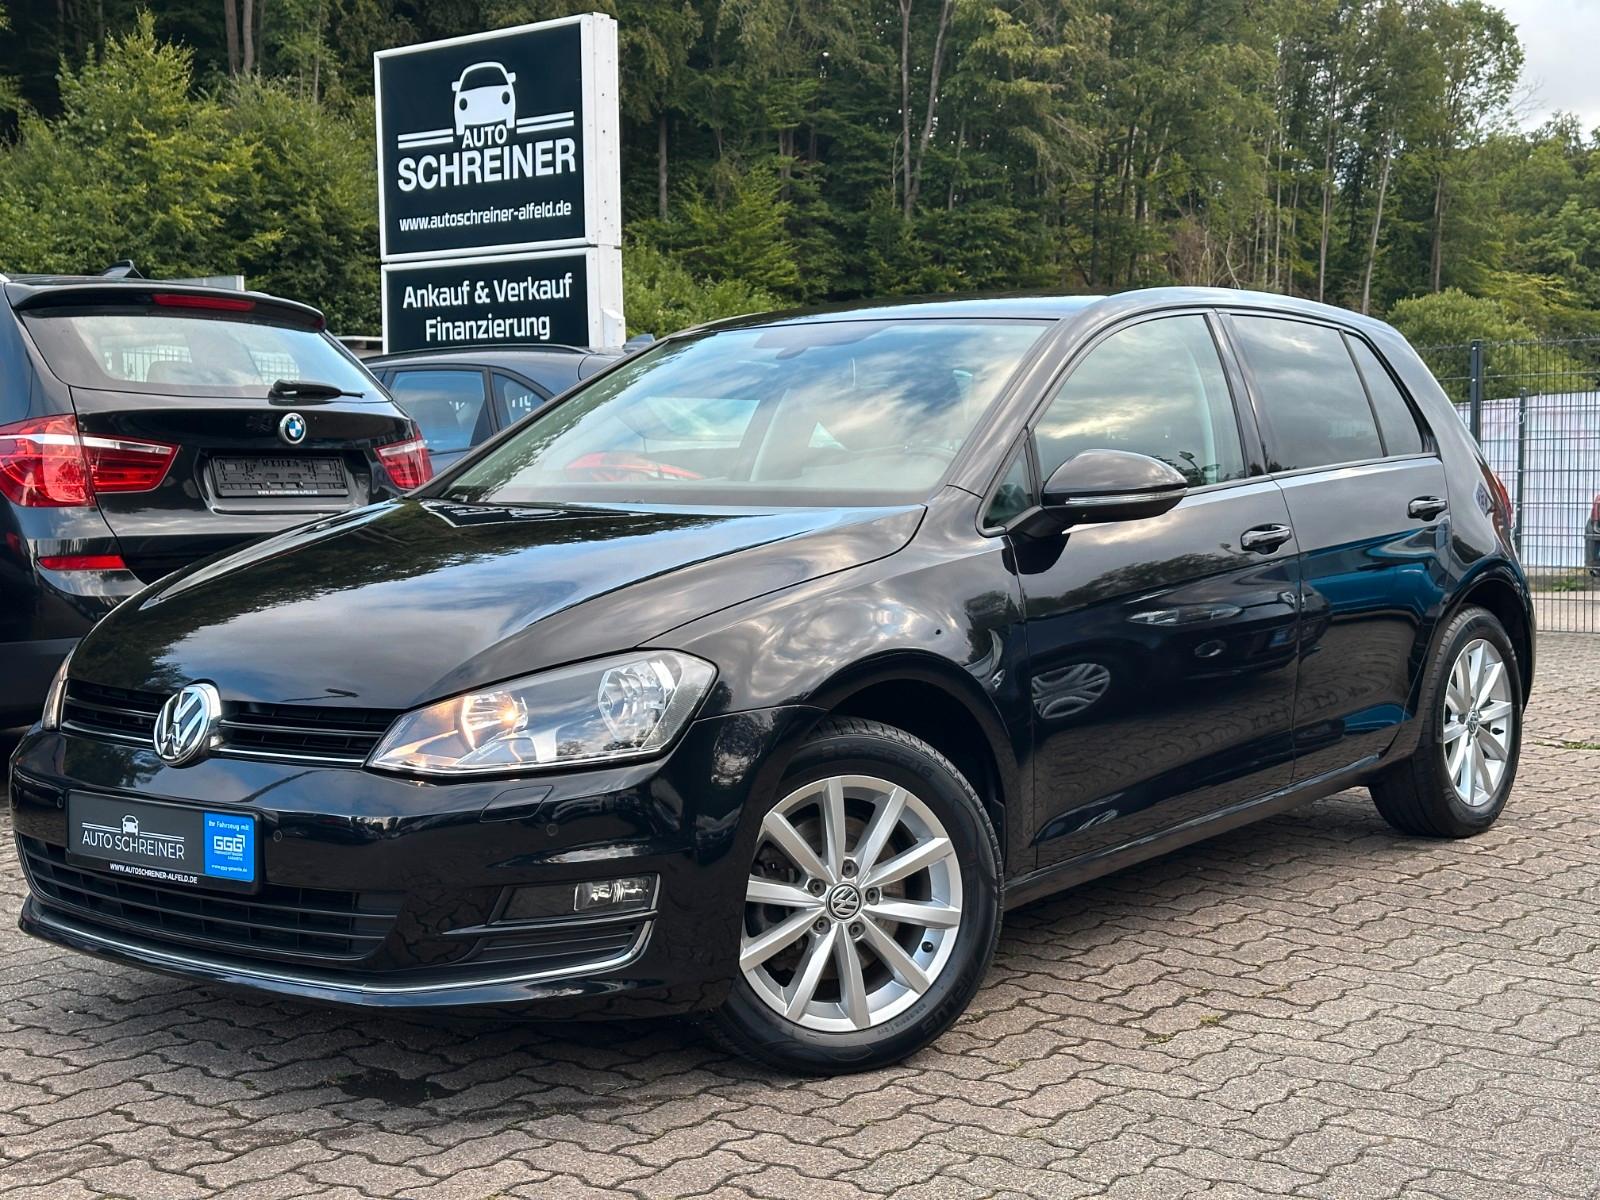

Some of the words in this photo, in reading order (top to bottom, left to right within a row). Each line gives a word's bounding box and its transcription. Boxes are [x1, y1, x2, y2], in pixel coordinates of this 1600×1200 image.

[462, 124, 507, 149] AUTO
[397, 137, 576, 192] SCHREINER
[399, 199, 572, 232] www.autoschreiner-alfeld.de
[402, 280, 470, 309] Ankauf
[475, 281, 491, 304] &
[493, 272, 573, 302] Verkauf
[425, 313, 551, 342] Finanzierung
[82, 830, 113, 849] AUTO
[114, 835, 185, 860] SCHREINER
[213, 835, 244, 852] GGG
[109, 863, 198, 884] WWW.AUTOSCHREINER-ALFELD.DE
